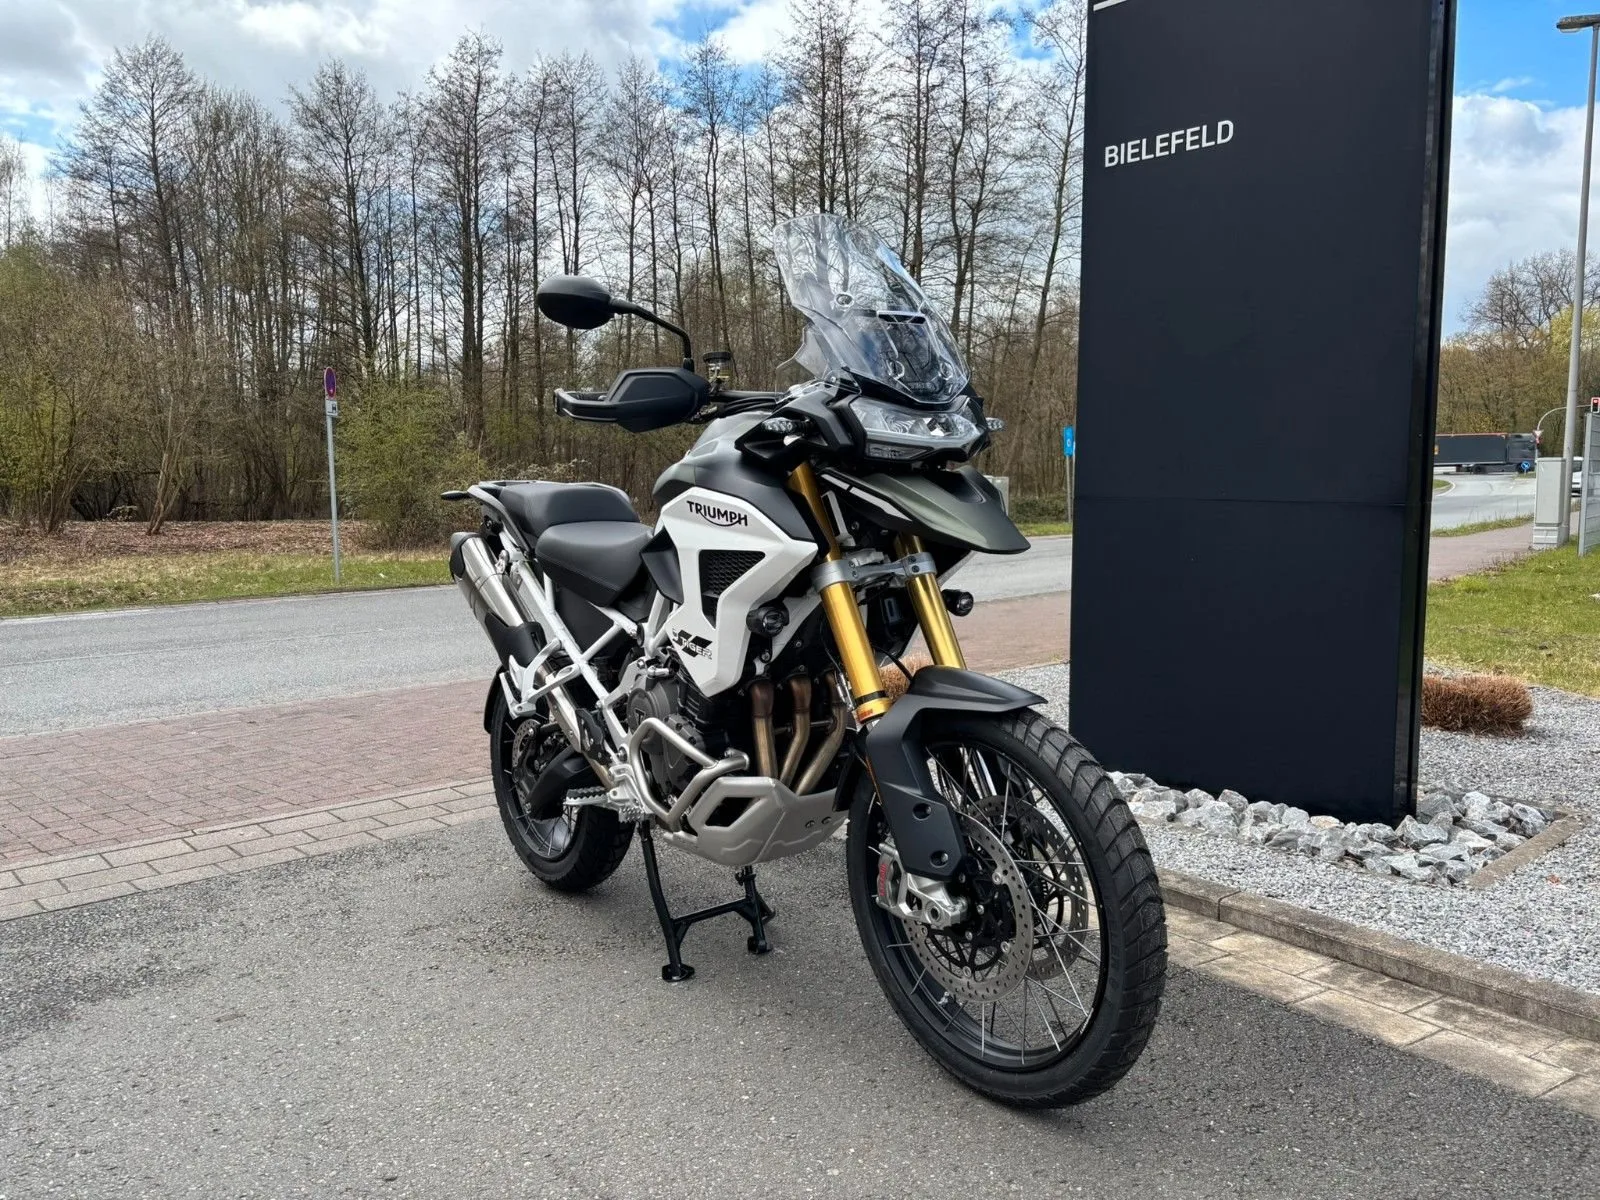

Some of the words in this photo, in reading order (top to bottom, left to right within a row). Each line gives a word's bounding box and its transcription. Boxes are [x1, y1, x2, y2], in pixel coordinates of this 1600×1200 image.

[1104, 119, 1234, 168] BIELEFELD
[686, 500, 748, 527] TRIUMPH
[680, 636, 713, 660] TIGER
